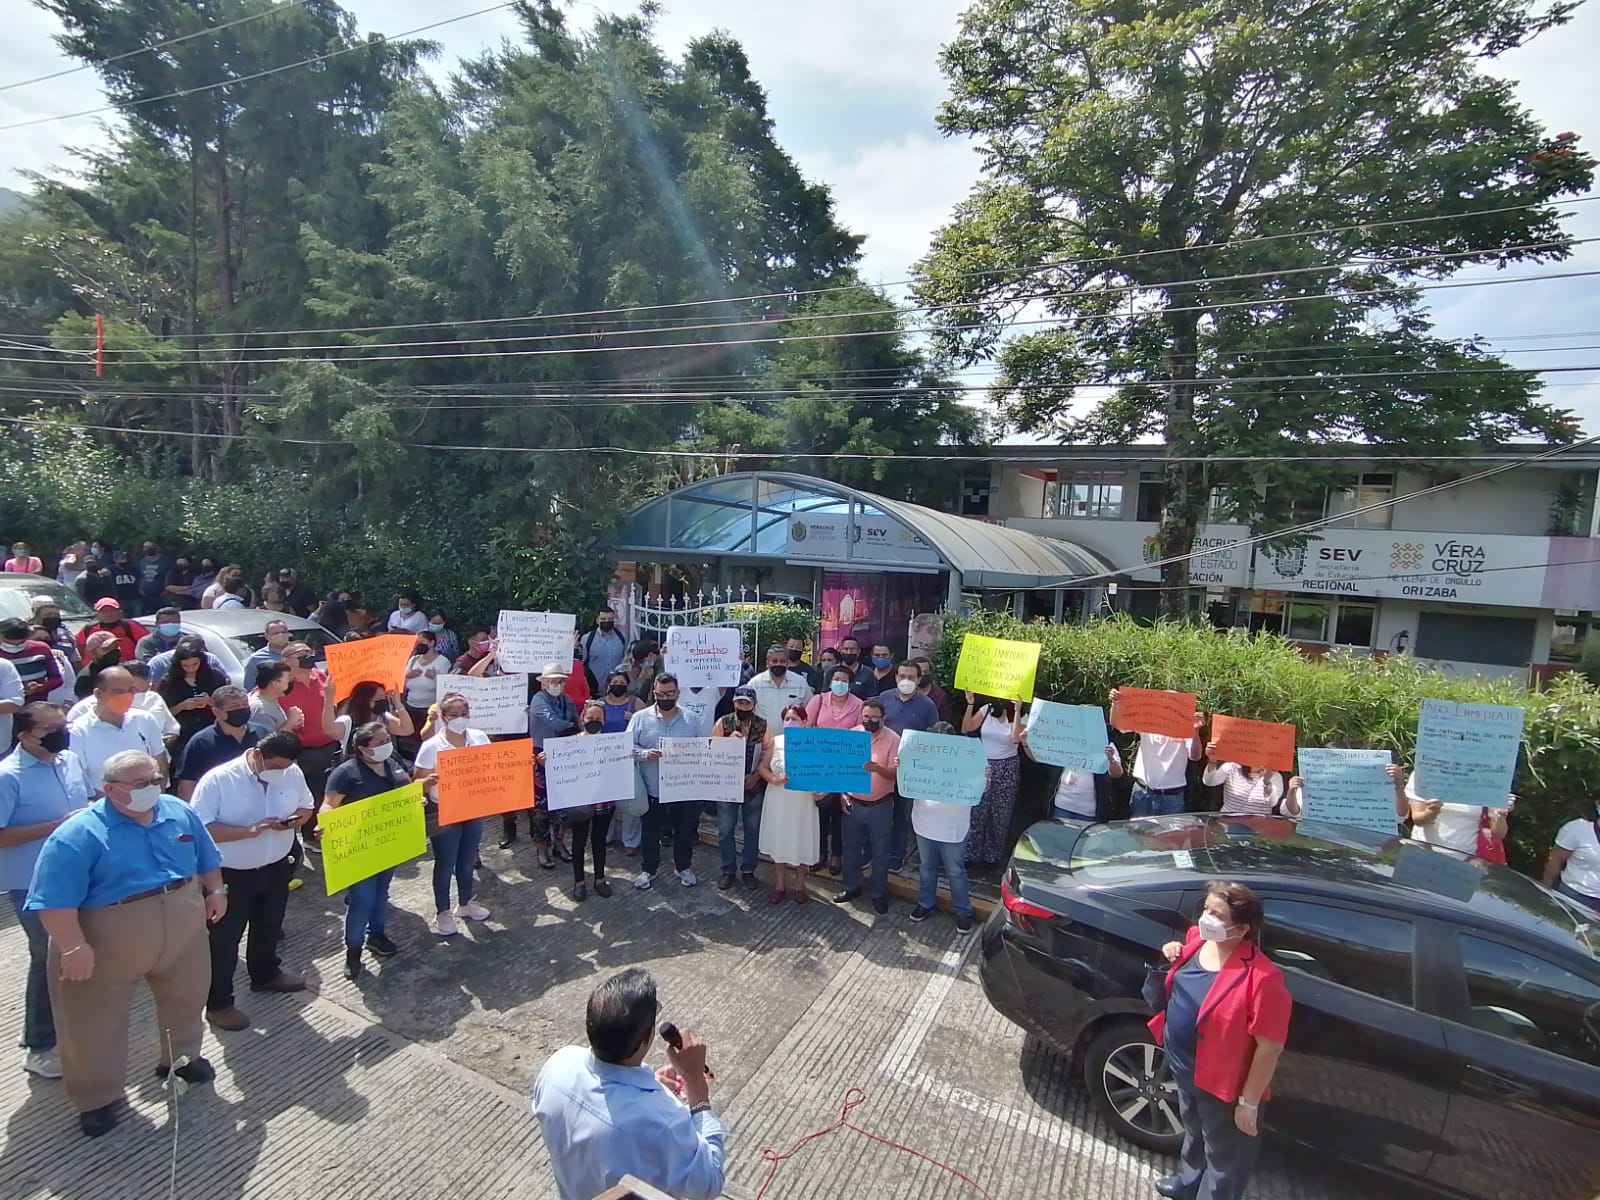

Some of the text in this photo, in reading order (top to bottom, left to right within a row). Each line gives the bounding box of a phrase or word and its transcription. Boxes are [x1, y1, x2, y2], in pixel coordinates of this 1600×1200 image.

[866, 528, 887, 537] SEV
[1191, 537, 1238, 549] ERACRUZ
[1434, 540, 1485, 559] VERA
[1319, 548, 1362, 561] SEV
[1200, 558, 1238, 570] ESTADO
[1432, 558, 1485, 577] CRUZ
[1314, 570, 1325, 578] de
[1401, 575, 1427, 583] LLENA
[1430, 576, 1440, 584] DE
[1445, 577, 1482, 586] ORGULLO
[1302, 579, 1359, 592] REGIONAL
[1402, 585, 1457, 598] ORIZABA
[695, 632, 707, 645] del
[330, 649, 357, 663] PAGO
[669, 656, 680, 665] del
[439, 750, 517, 769] ENTREGA DE LAS
[482, 763, 493, 773] DE
[441, 782, 452, 792] DE
[468, 785, 508, 797] TEMPORAL
[328, 813, 357, 834] PAGO
[361, 808, 379, 821] DEL
[331, 812, 413, 850] DEL INCREMENTO
[332, 831, 398, 865] SALARIAL 2022
